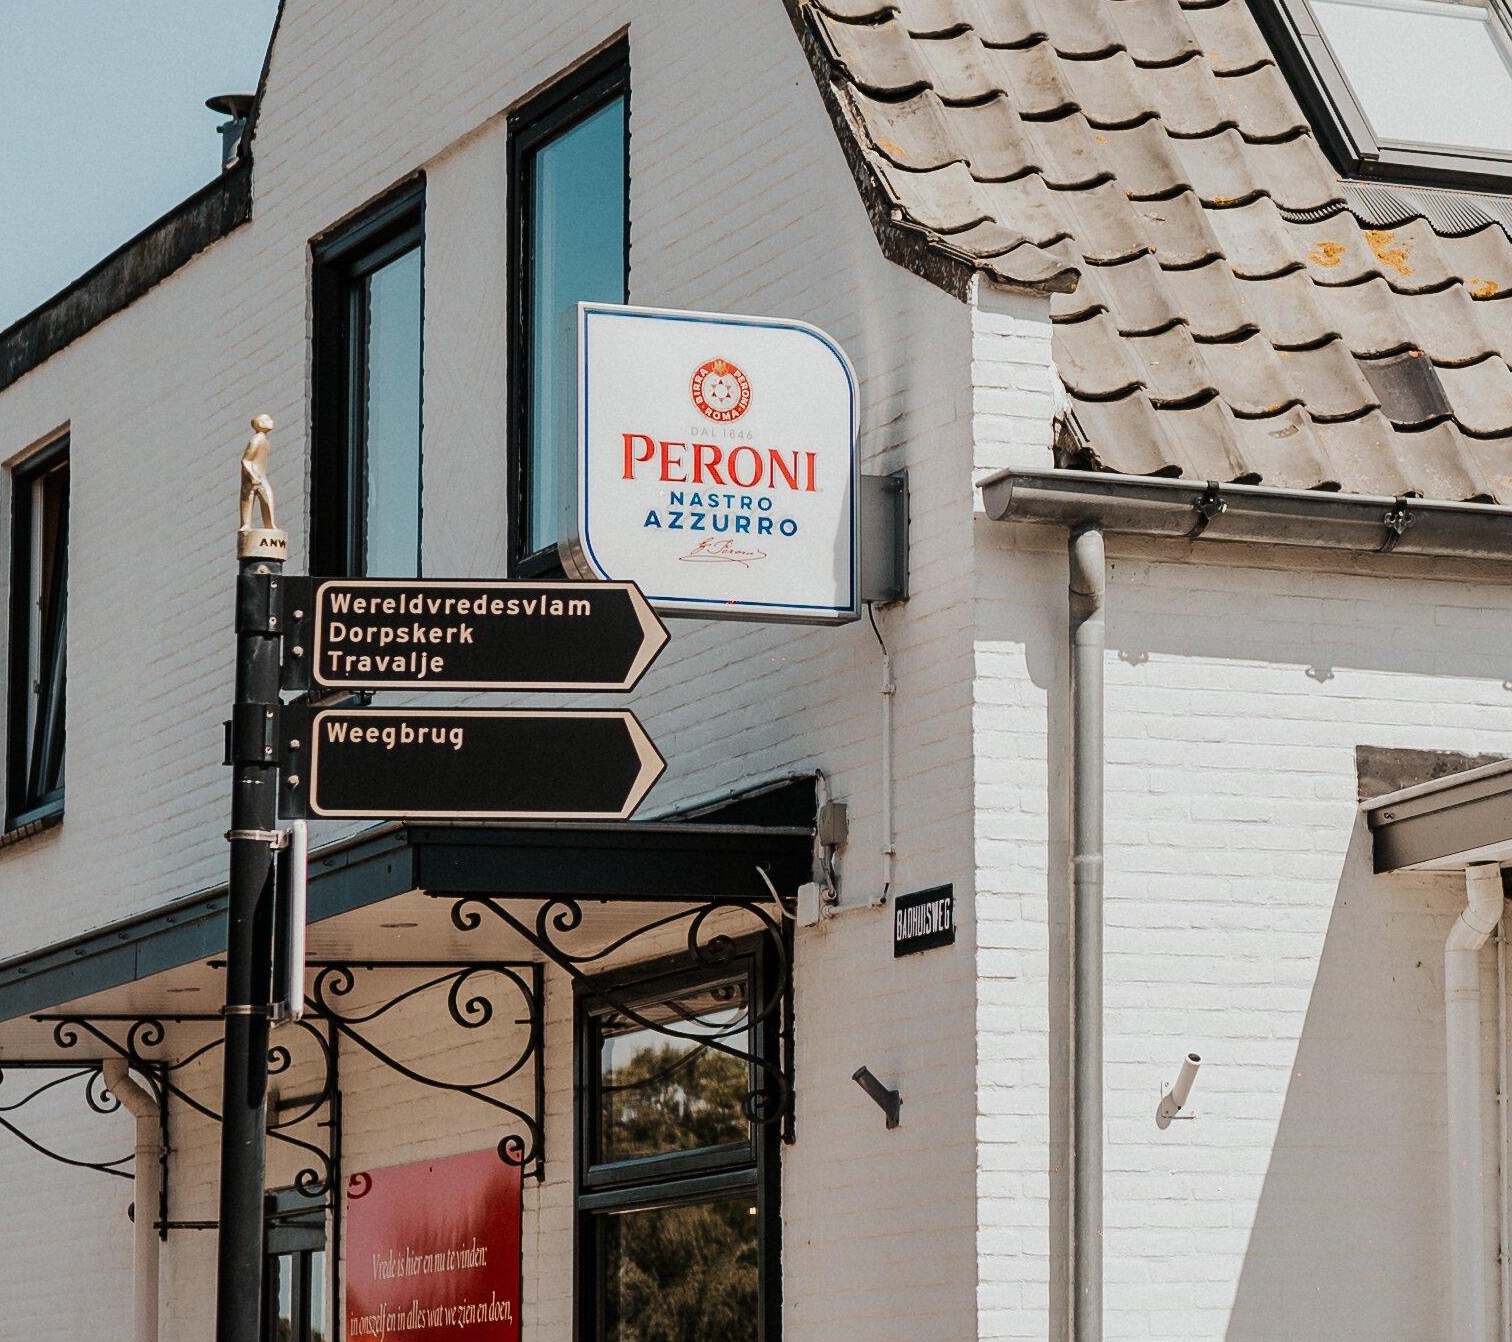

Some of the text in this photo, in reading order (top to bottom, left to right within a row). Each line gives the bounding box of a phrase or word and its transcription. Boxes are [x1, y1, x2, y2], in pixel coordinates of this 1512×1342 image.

[693, 368, 709, 405] BIRRA
[733, 369, 750, 410] PERONI
[704, 409, 740, 421] ROMA
[691, 426, 753, 440] DAL 1846
[621, 433, 817, 492] PERONI
[670, 490, 773, 511] NASTRO
[643, 509, 798, 537] AZZURRO
[259, 538, 286, 548] ANW
[330, 593, 592, 616] Wereldvredesvlam
[328, 622, 475, 646] Dorpskerk
[327, 650, 445, 679] Travalje
[326, 722, 465, 751] Weegbrug
[896, 897, 951, 941] BADHUISWEG
[373, 1249, 396, 1280] Vrede
[396, 1252, 405, 1278] is
[406, 1247, 423, 1276] hier
[423, 1255, 433, 1274] en
[434, 1253, 445, 1272] nu
[447, 1251, 456, 1271] te
[350, 1291, 513, 1342] in onszelf en in alles wat we zien en doen,
